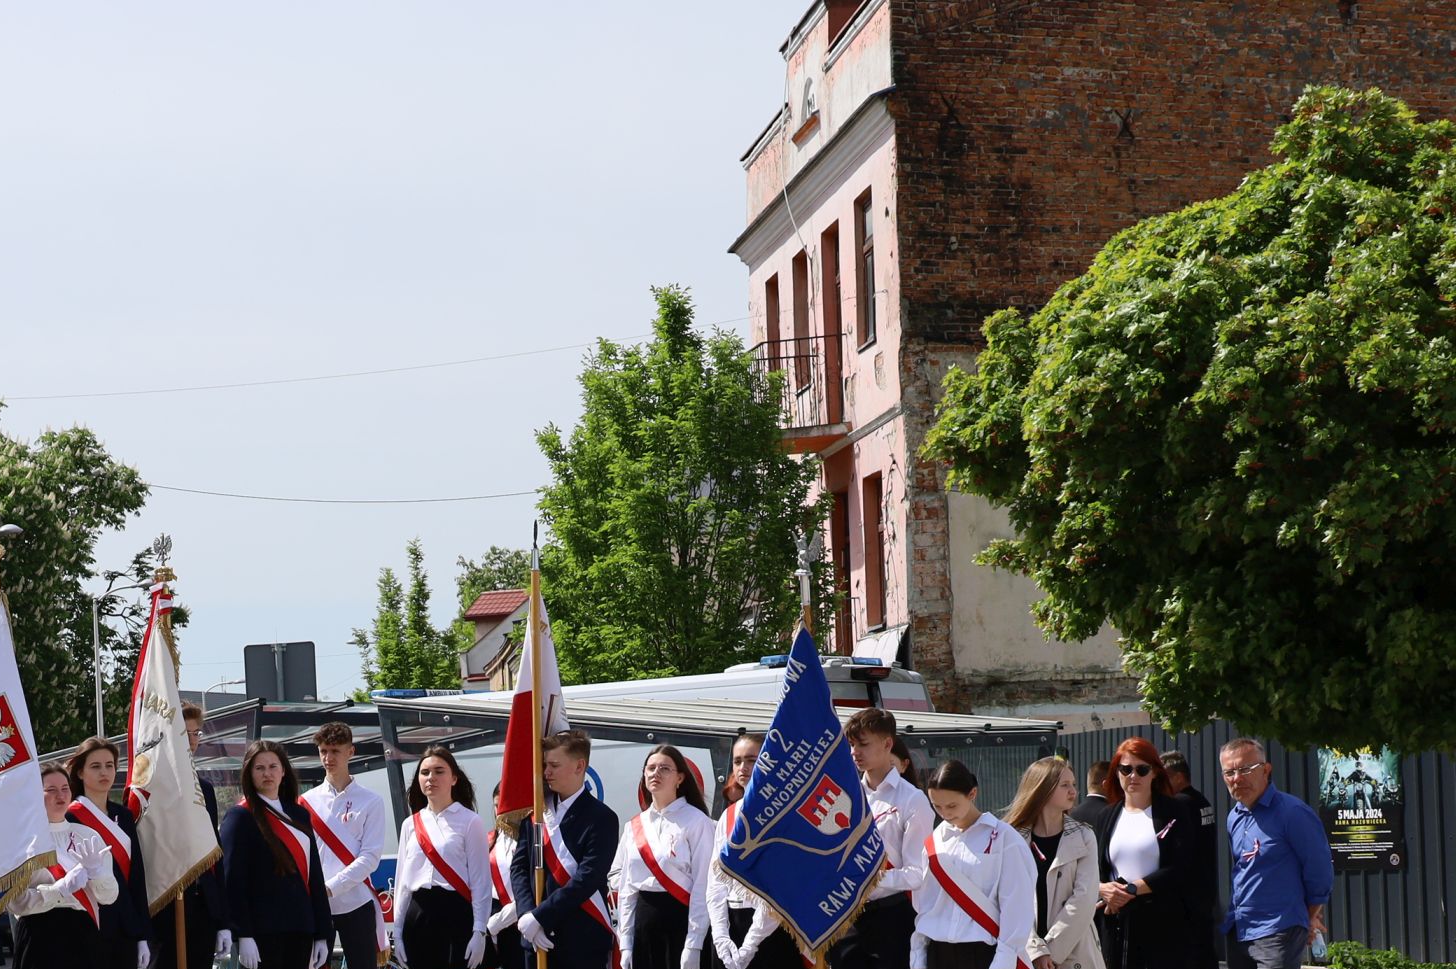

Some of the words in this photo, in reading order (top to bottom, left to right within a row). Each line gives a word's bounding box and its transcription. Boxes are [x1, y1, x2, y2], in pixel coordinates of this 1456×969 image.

[756, 751, 779, 776] NR
[769, 728, 795, 753] 2
[776, 739, 812, 782] MARII
[754, 728, 836, 826] KONOPNICKIEJ
[1337, 809, 1343, 820] 5
[1343, 809, 1364, 820] MAJA
[1365, 807, 1383, 819] 2024
[818, 876, 857, 917] RAWA
